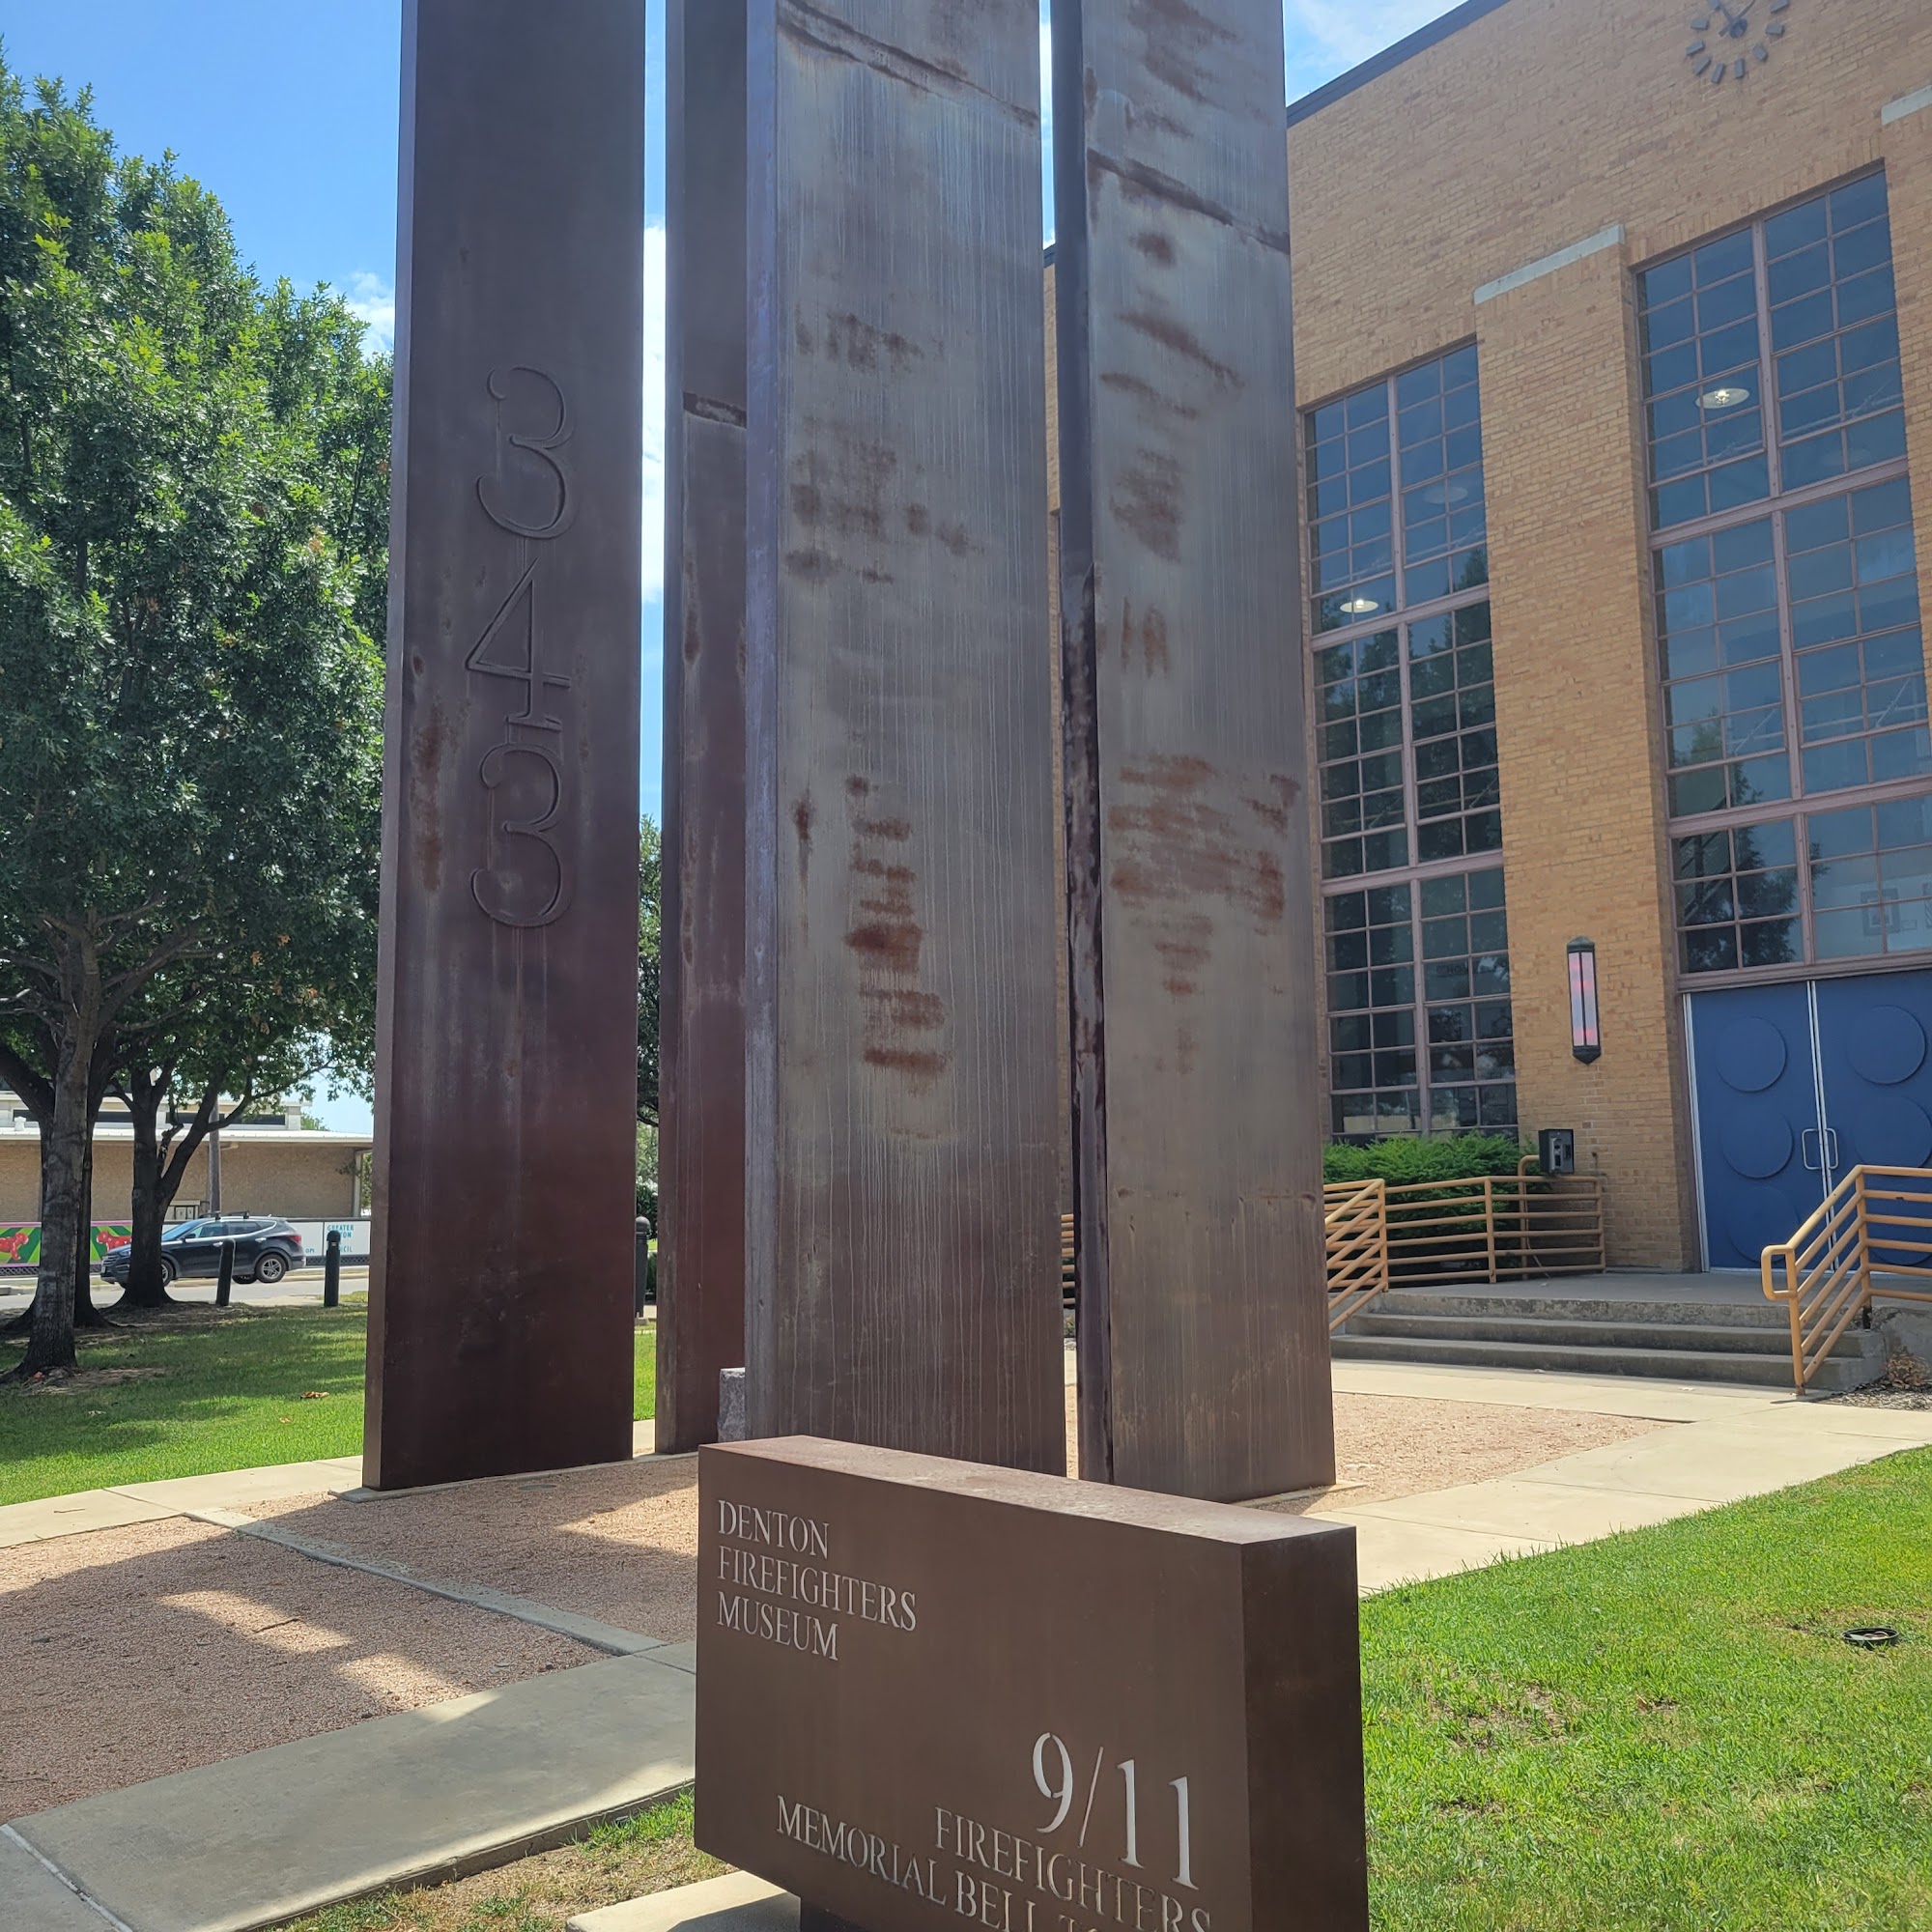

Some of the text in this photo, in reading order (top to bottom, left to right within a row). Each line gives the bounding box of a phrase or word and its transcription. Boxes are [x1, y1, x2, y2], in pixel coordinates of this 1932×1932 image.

[466, 364, 575, 927] 343
[718, 1499, 830, 1559] DENTON
[717, 1591, 838, 1661] MUSEUM
[718, 1546, 917, 1631] FIREFIGHTERS
[776, 1795, 947, 1905] MEMORIAL
[1033, 1732, 1199, 1889] 9/11
